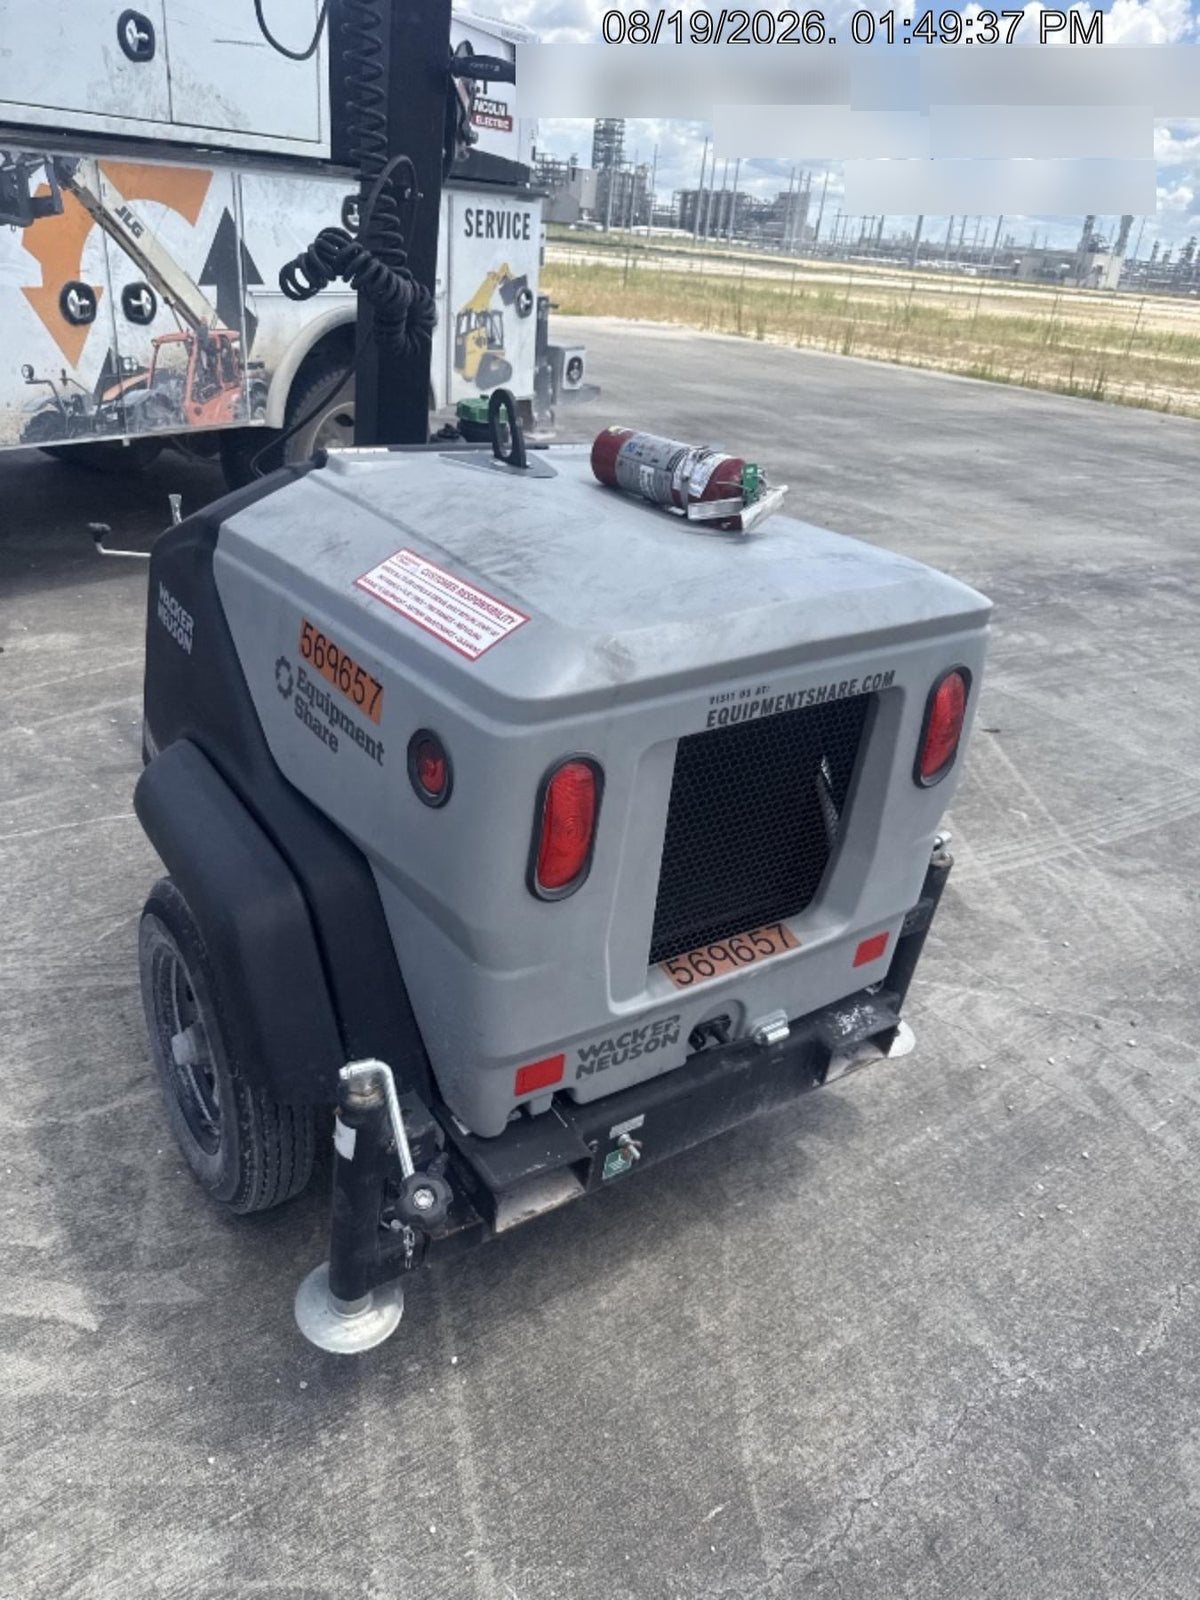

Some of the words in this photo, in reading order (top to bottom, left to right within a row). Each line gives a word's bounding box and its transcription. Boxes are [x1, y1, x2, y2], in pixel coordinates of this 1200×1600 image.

[475, 114, 511, 130] ELECTRIC
[114, 205, 145, 240] JLG
[464, 207, 531, 241] SERVICE
[157, 600, 193, 656] NEUSON
[159, 580, 195, 636] WACKER
[300, 620, 384, 716] 569657
[294, 693, 339, 754] Share
[296, 665, 385, 767] Equipment
[706, 669, 897, 728] EQUIPMENTSHARE.COM
[709, 691, 736, 706] VISIT
[665, 922, 792, 986] 569657
[575, 1029, 681, 1081] NEUSON
[577, 1014, 681, 1063] WACKER
